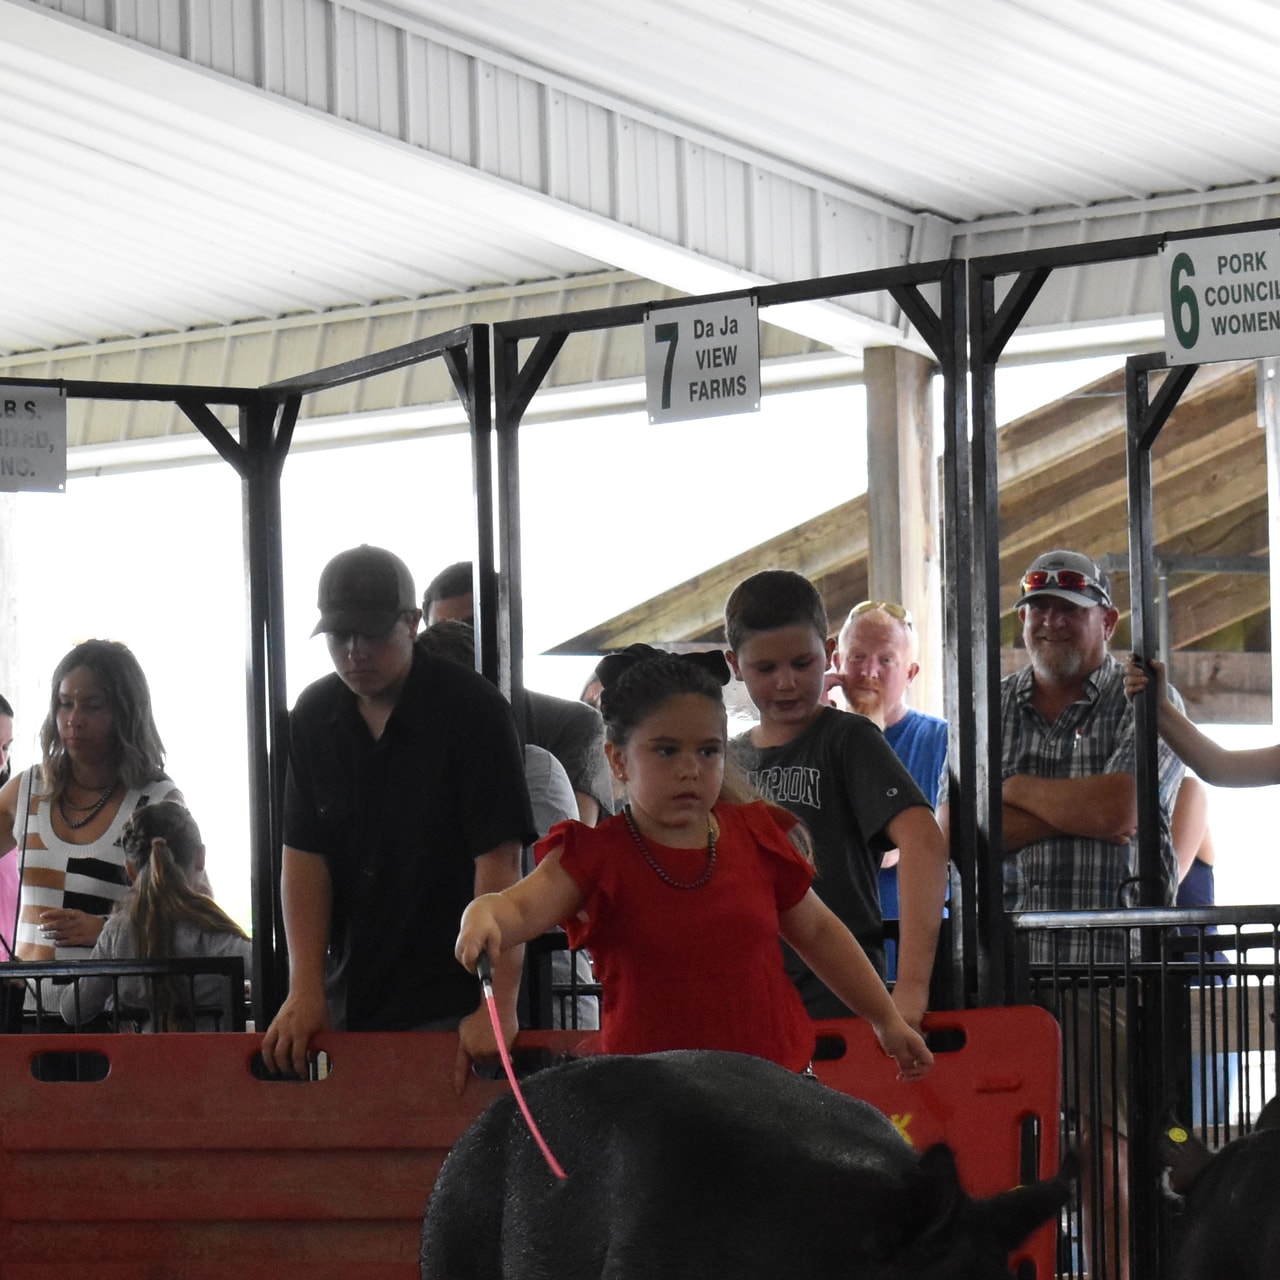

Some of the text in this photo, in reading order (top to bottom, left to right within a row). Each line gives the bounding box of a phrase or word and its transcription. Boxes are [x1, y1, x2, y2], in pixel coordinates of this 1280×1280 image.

[1217, 251, 1268, 275] PORK
[1170, 252, 1200, 350] 6
[693, 315, 739, 340] Da Ja
[654, 322, 679, 410] 7
[695, 345, 738, 371] VIEW
[689, 375, 747, 402] FARMS
[747, 765, 821, 809] MPION
